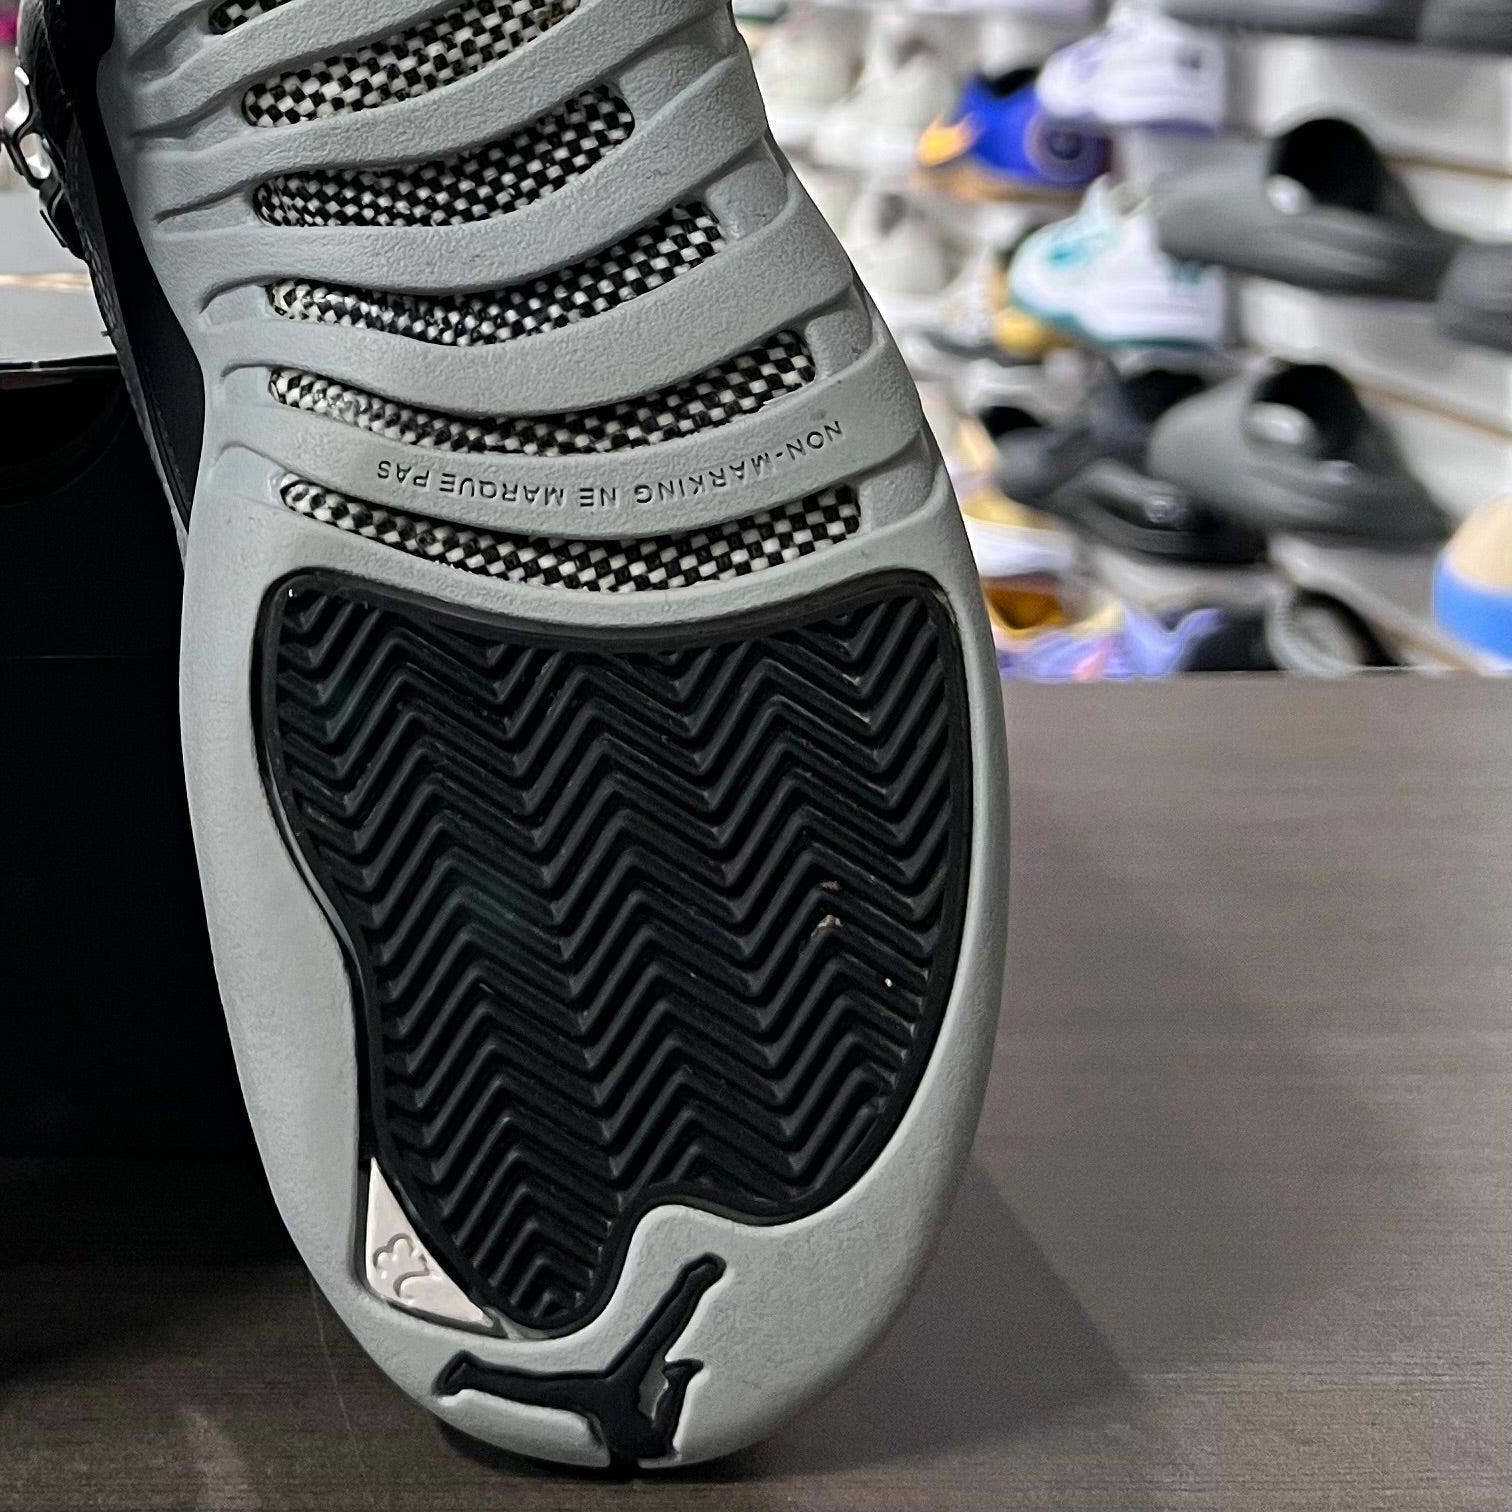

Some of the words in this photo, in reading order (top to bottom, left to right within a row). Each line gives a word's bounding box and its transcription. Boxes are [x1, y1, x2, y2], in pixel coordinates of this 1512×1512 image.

[376, 459, 431, 490] PAS
[633, 419, 844, 505] NON-MARKING
[439, 473, 566, 507] MARQUE
[579, 486, 617, 508] NE
